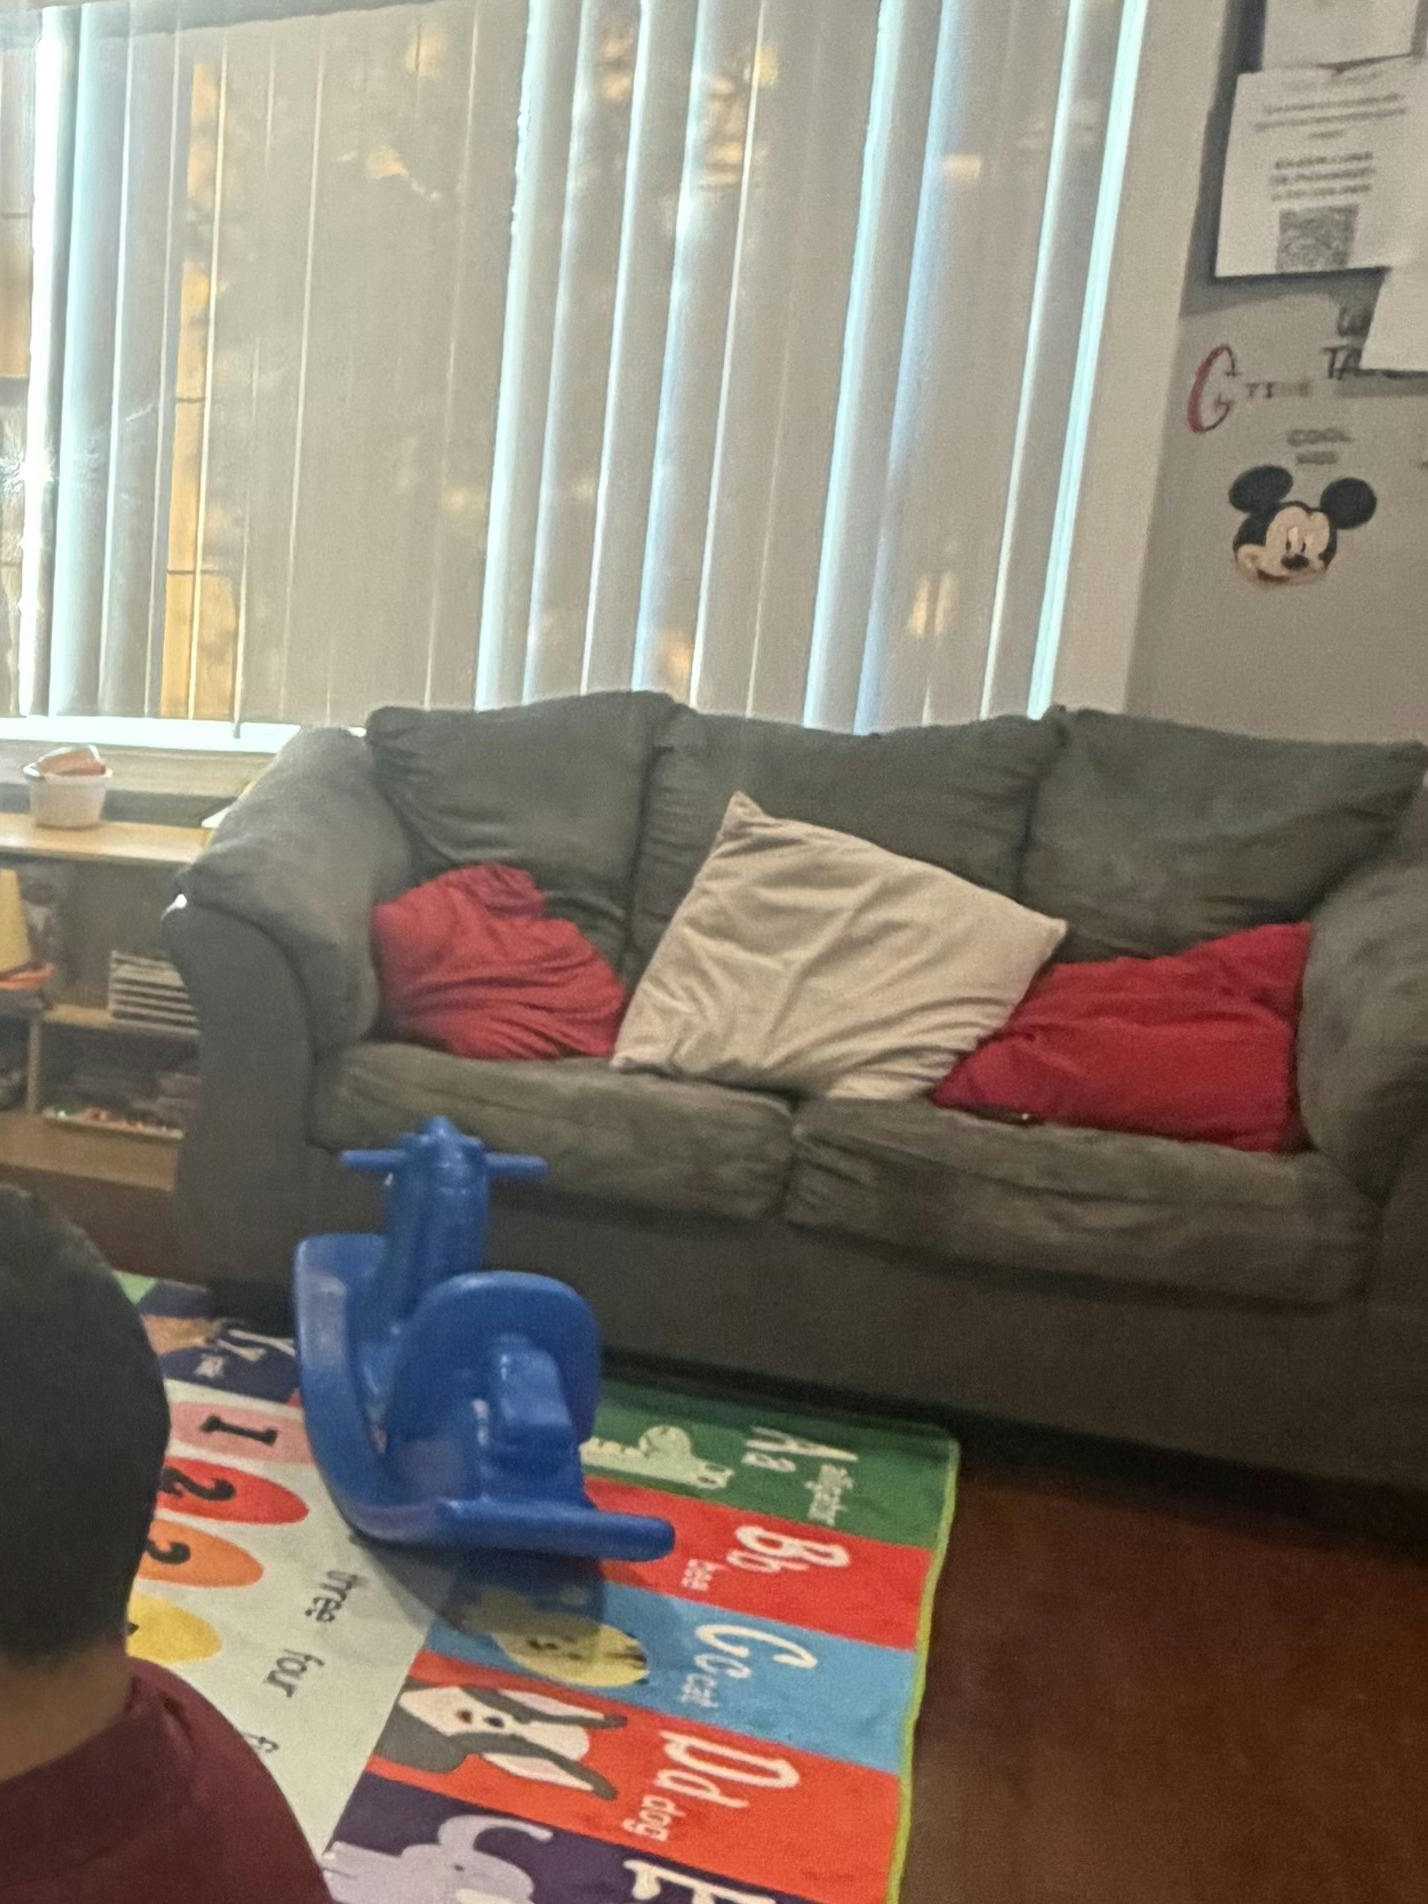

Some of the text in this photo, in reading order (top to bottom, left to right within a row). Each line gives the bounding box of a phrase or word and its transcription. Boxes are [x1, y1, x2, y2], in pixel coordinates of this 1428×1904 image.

[200, 1413, 279, 1448] 1
[159, 1457, 238, 1504] 2
[263, 1649, 327, 1699] four
[678, 1672, 722, 1710] cat
[618, 1794, 680, 1844] dog
